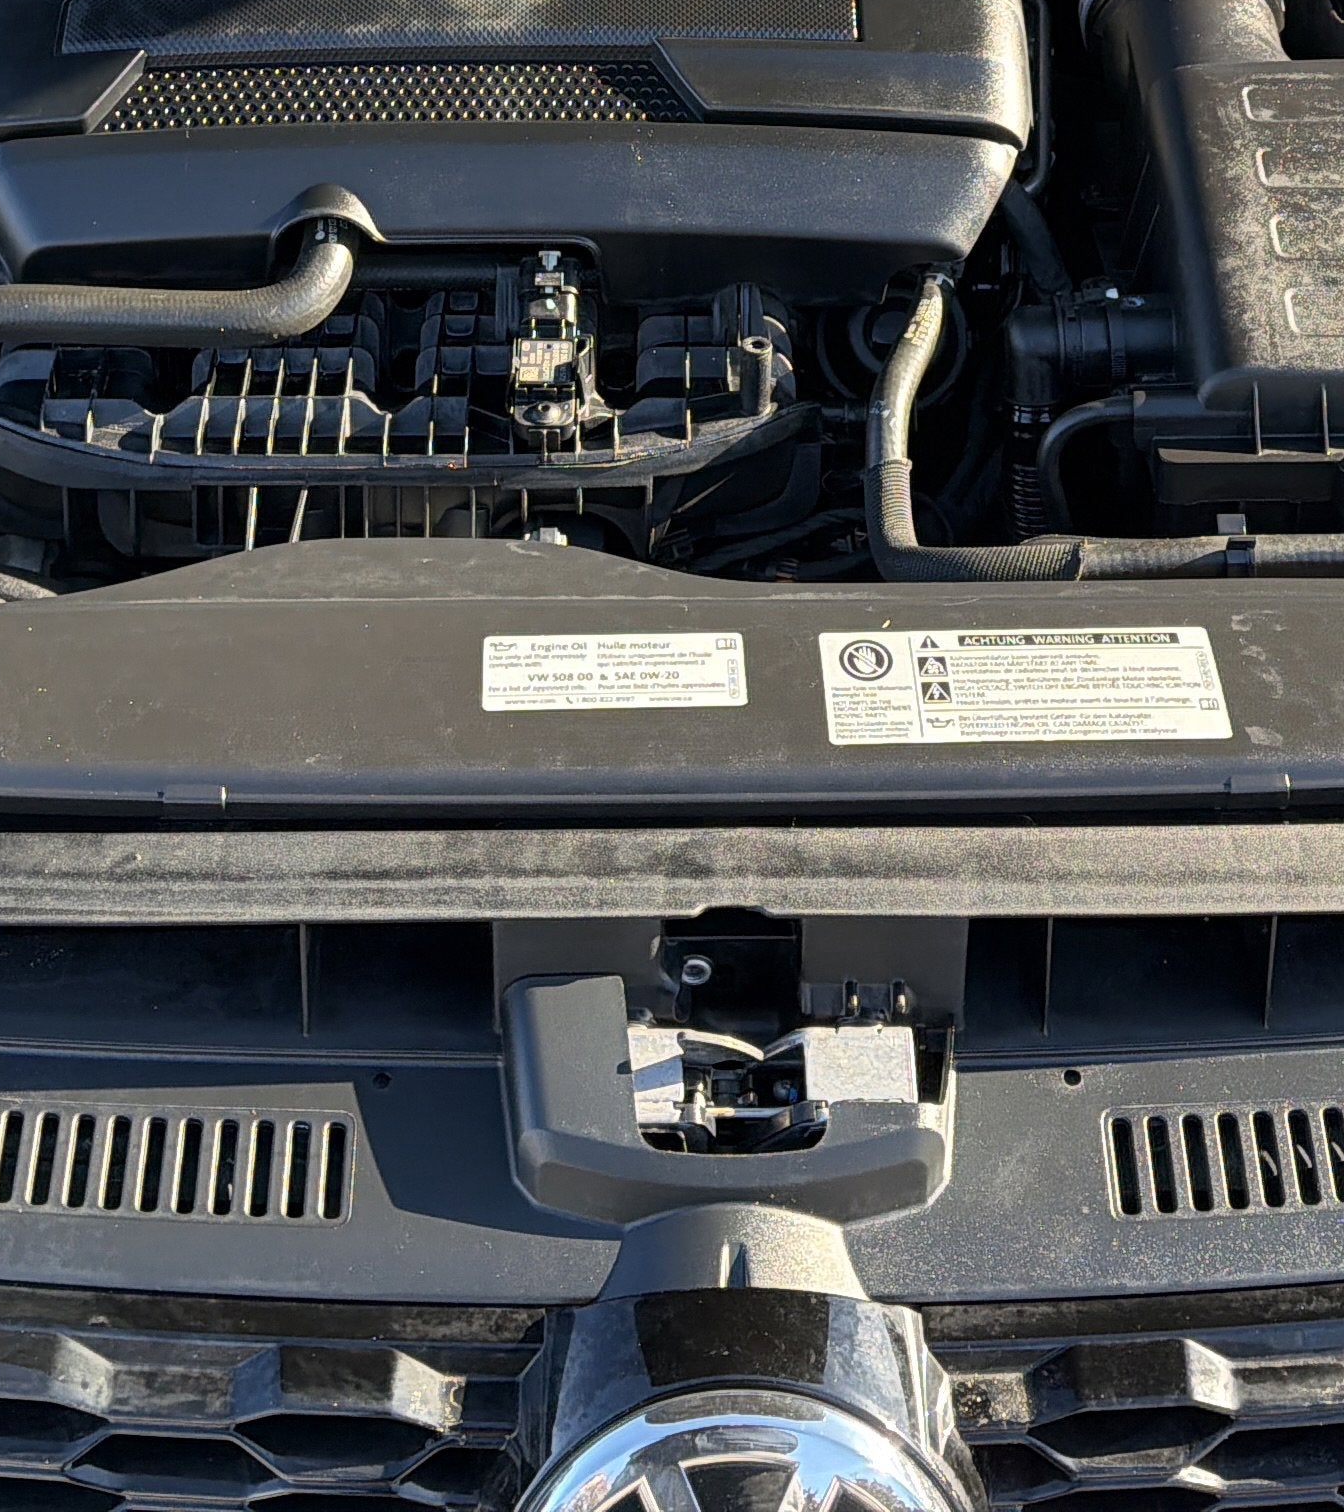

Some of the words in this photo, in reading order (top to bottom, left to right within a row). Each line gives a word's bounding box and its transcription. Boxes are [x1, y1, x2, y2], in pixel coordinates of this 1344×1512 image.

[963, 636, 1026, 646] ACHTUNG
[1032, 635, 1095, 645] WARNING
[1102, 633, 1171, 644] ATTENTION
[531, 642, 568, 653] Engine
[571, 642, 587, 650] Oil
[598, 641, 626, 650] Huile
[528, 674, 549, 682] VW
[552, 673, 573, 681] 508
[578, 672, 593, 681] 00
[615, 672, 636, 681] SAE
[640, 671, 680, 680] 0W-20
